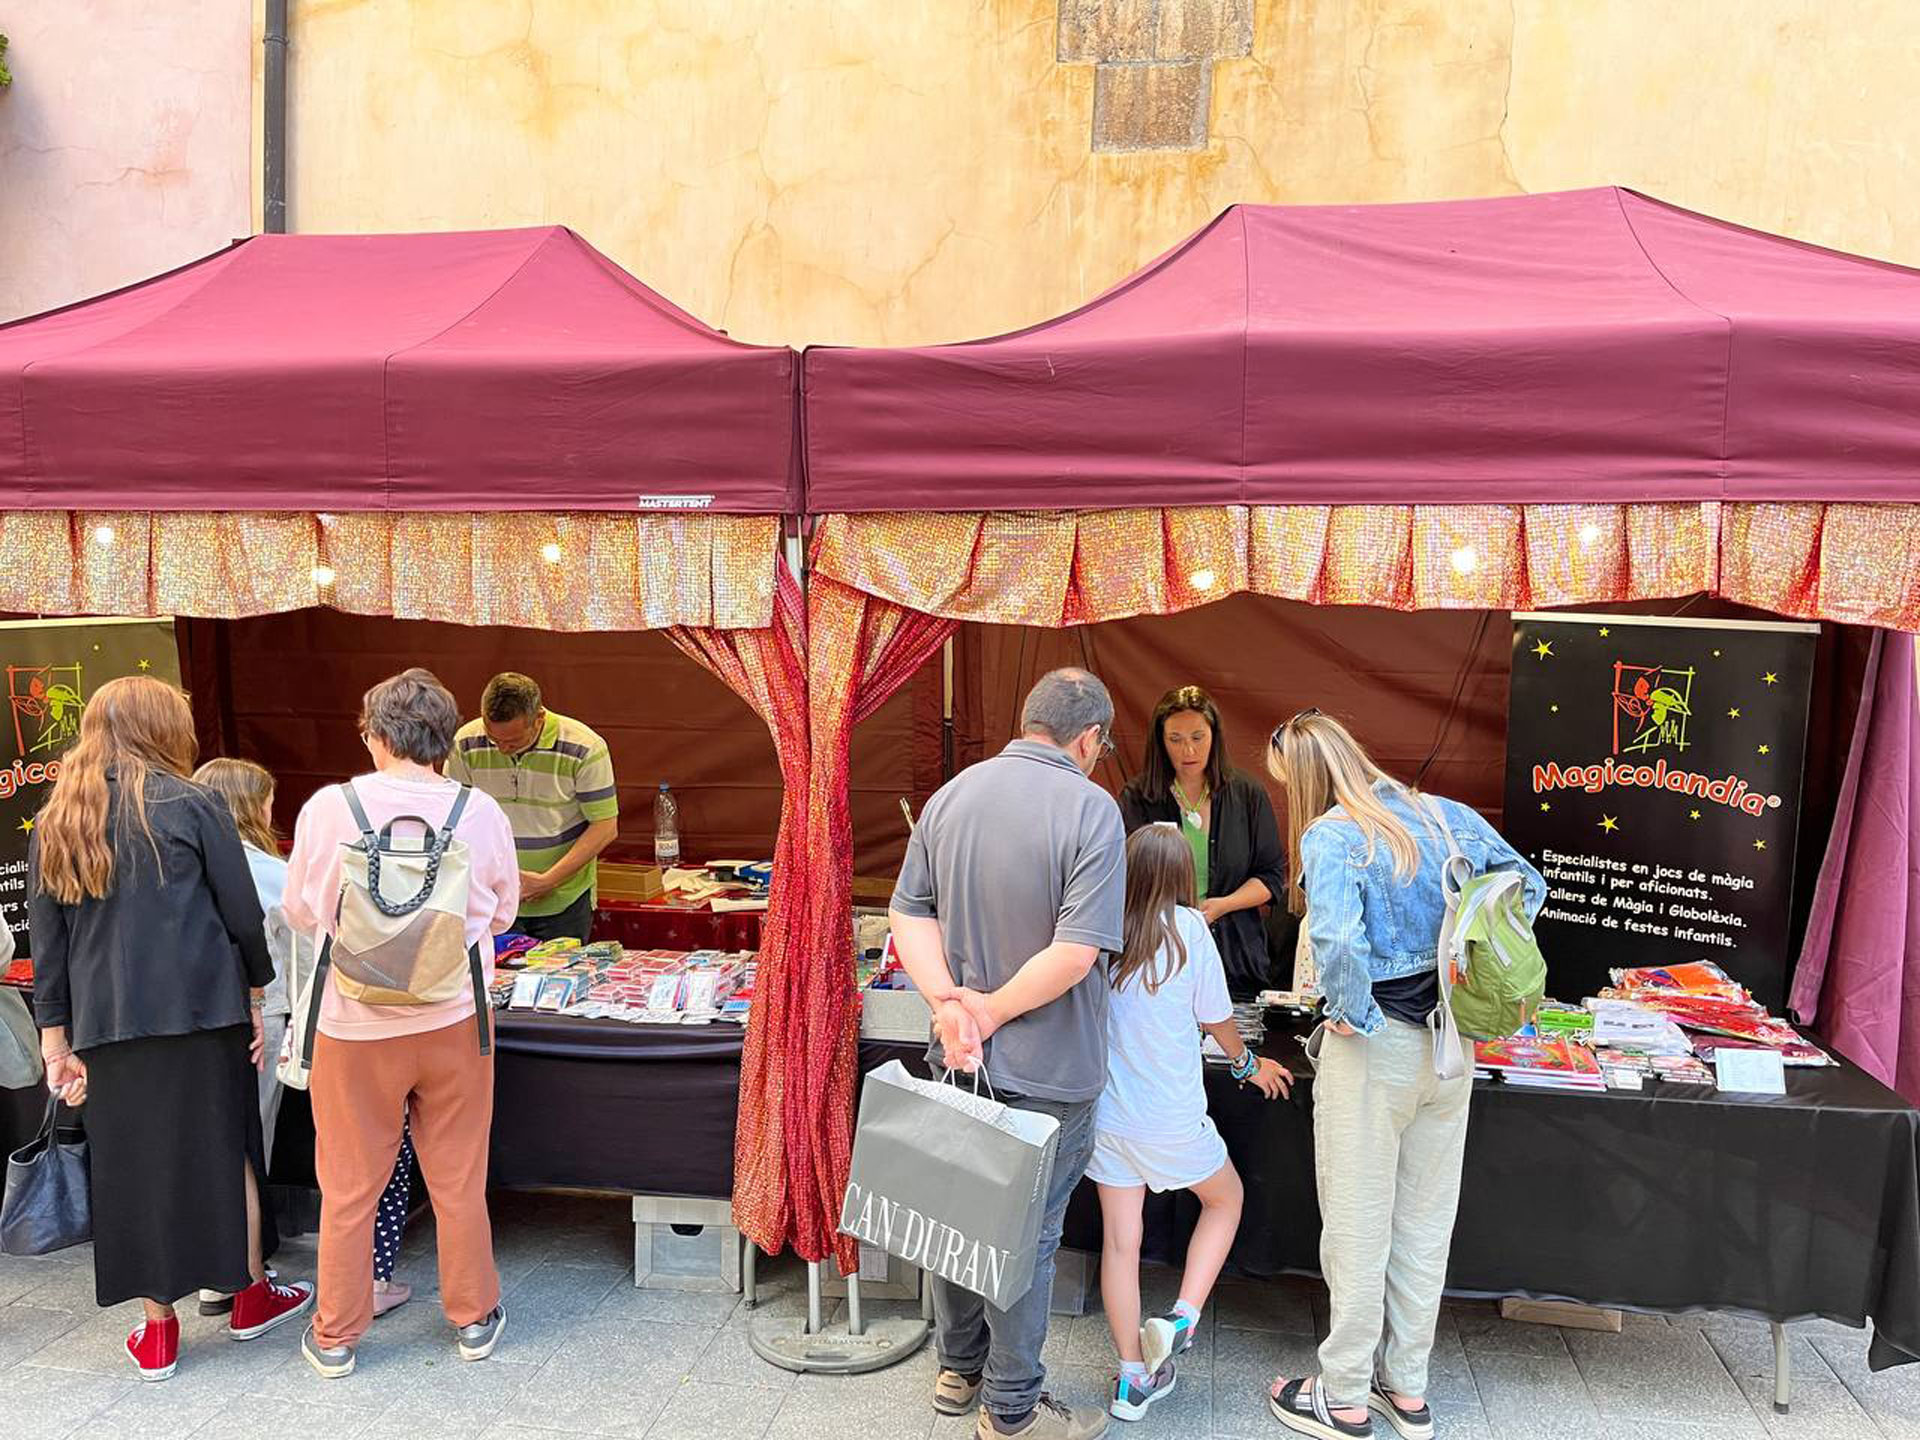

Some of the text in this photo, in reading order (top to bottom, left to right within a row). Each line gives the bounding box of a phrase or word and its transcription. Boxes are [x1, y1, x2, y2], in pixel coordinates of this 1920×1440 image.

[1542, 849, 1754, 890] Especialistes en jocs de màgia
[1542, 866, 1713, 901] infantils i per aficionats.
[1539, 907, 1737, 948] Animació de festes infantils.
[1591, 893, 1607, 906] de
[1612, 896, 1654, 914] Màgia
[1659, 902, 1664, 914] i
[1669, 904, 1747, 928] Globolèxia.
[838, 1182, 1011, 1300] CAN DURAN
